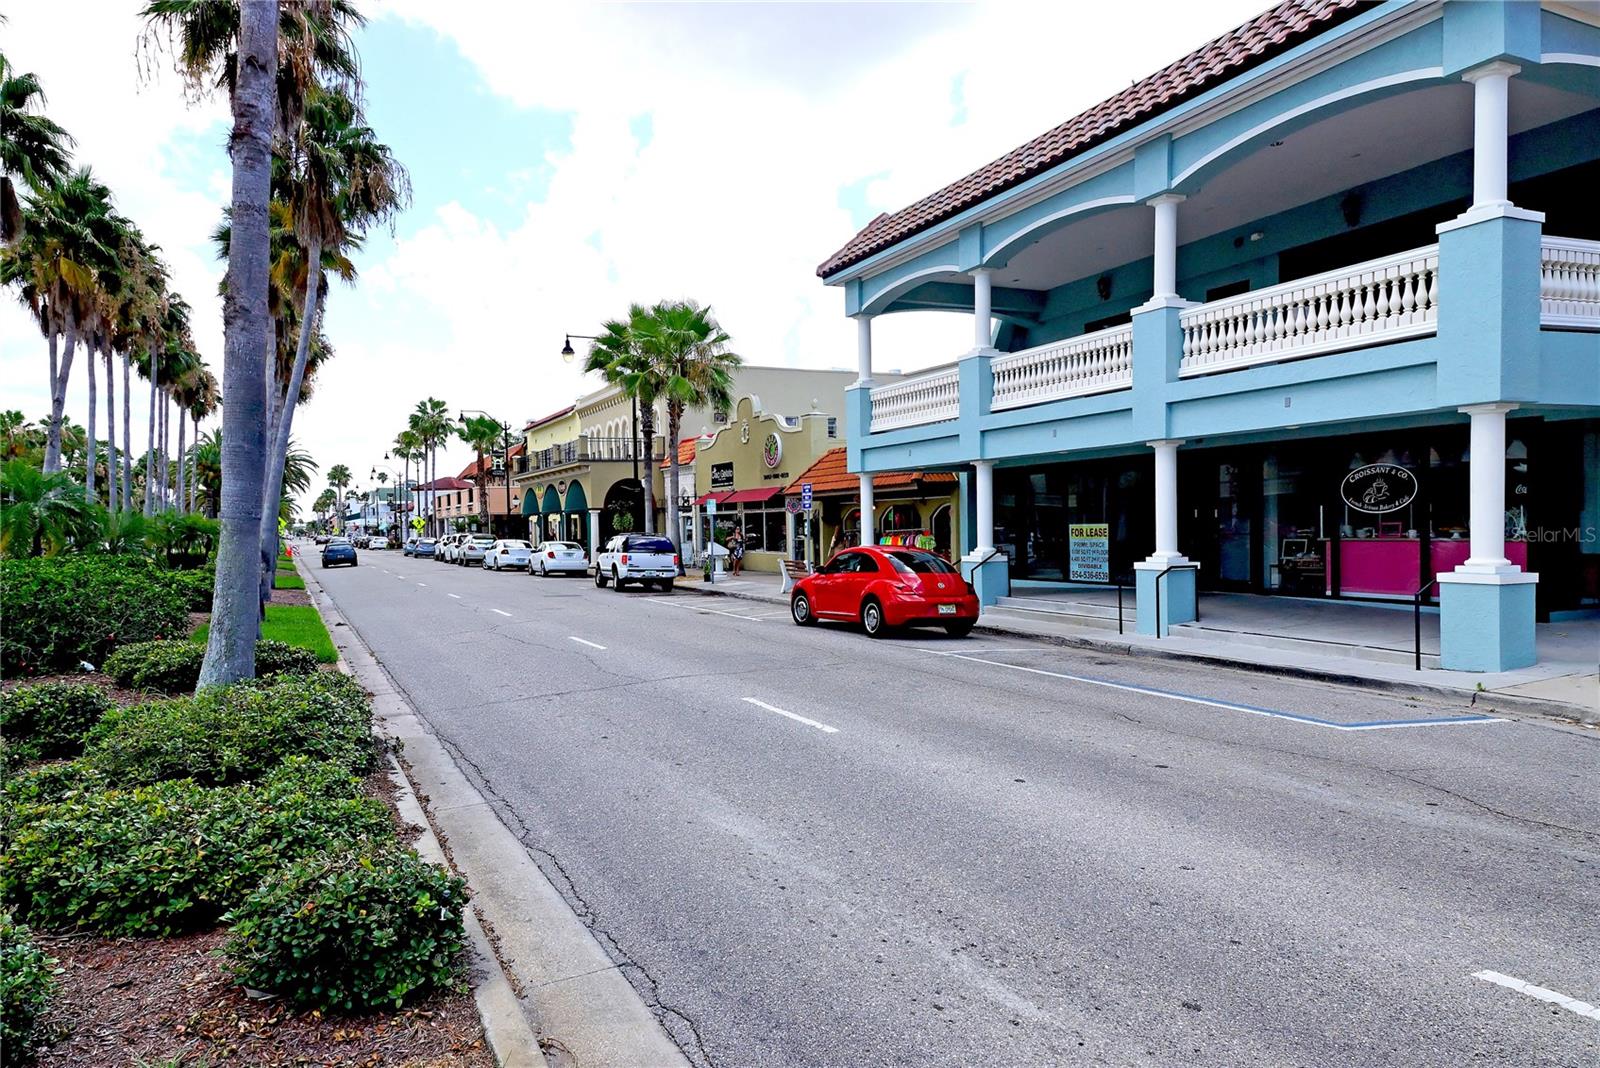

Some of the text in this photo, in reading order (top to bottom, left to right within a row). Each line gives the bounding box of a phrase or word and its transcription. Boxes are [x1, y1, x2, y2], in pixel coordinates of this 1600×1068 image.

[1349, 467, 1390, 483] CROISSANT
[1397, 470, 1408, 481] CO.
[1071, 528, 1108, 538] FOR LEASE
